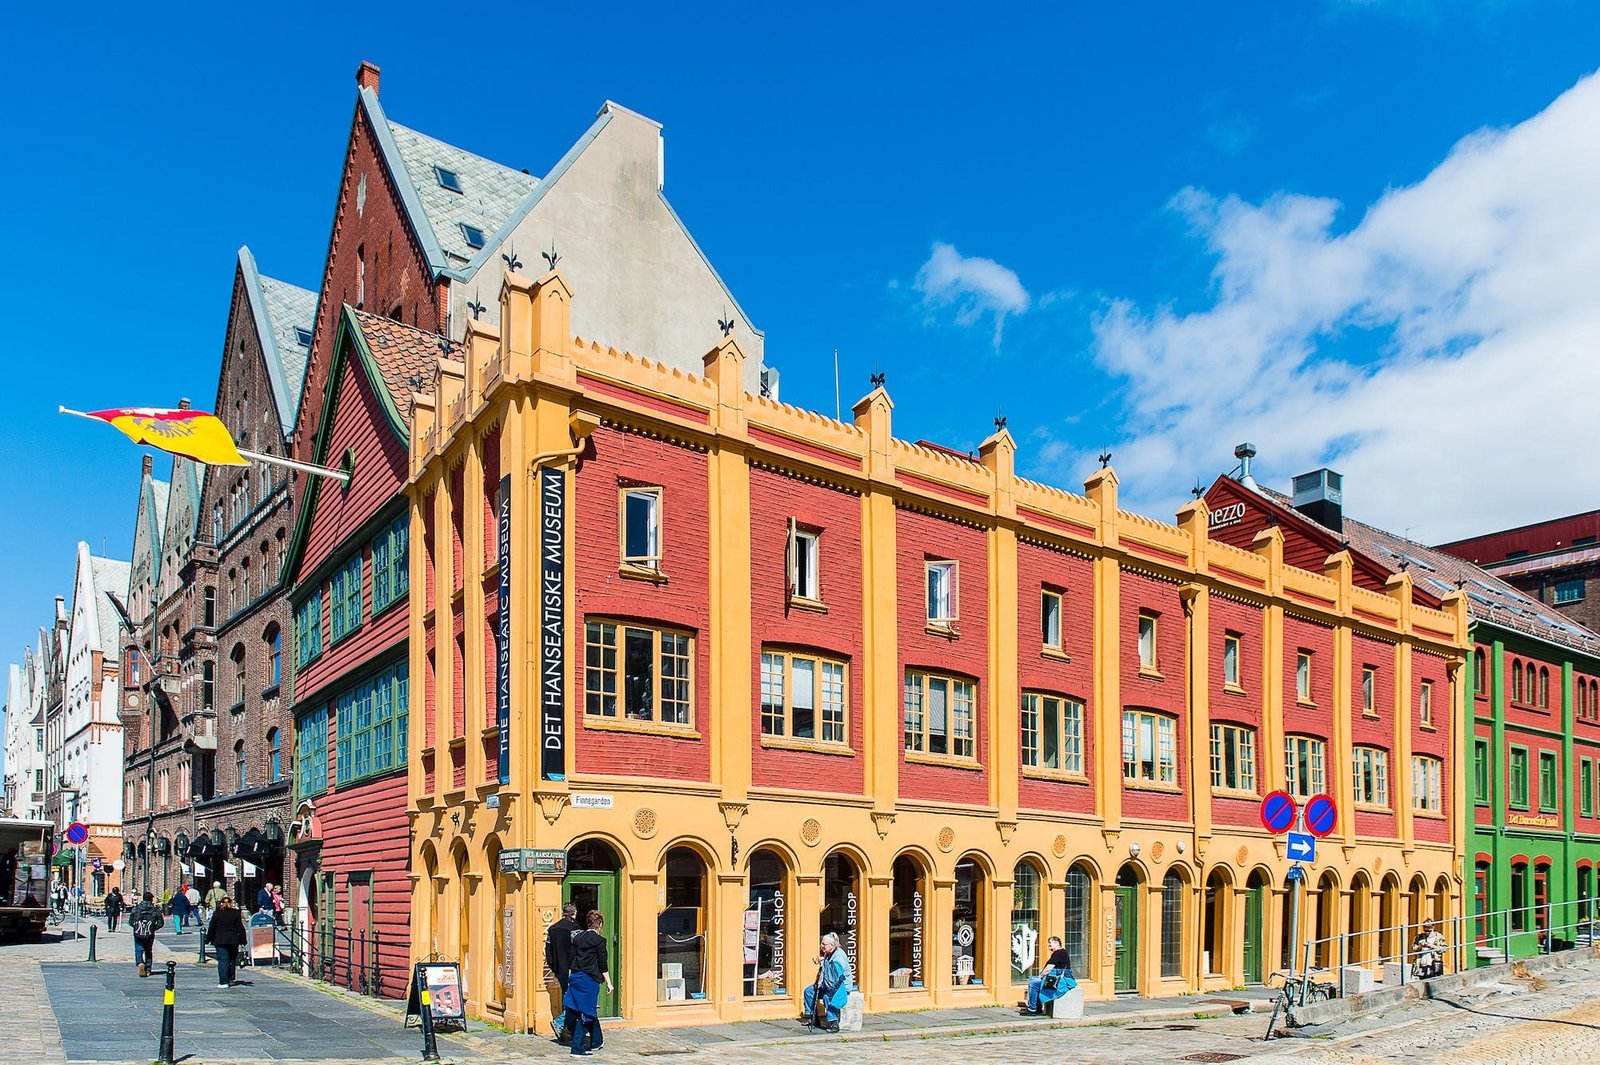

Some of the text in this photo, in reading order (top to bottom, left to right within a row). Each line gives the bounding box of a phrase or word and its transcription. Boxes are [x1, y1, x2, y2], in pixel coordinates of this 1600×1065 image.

[500, 498, 509, 755] THE HANSEATIC MUSEUM
[545, 475, 562, 750] DET HANSEATISKE MUSEUM
[505, 909, 513, 984] ENTRANCE
[542, 909, 555, 984] INNG
[774, 890, 785, 985] MUSEUM SHOP
[847, 892, 857, 926] SHOP
[912, 891, 923, 978] MUSEUM SHOP
[1105, 913, 1114, 958] KONTOR
